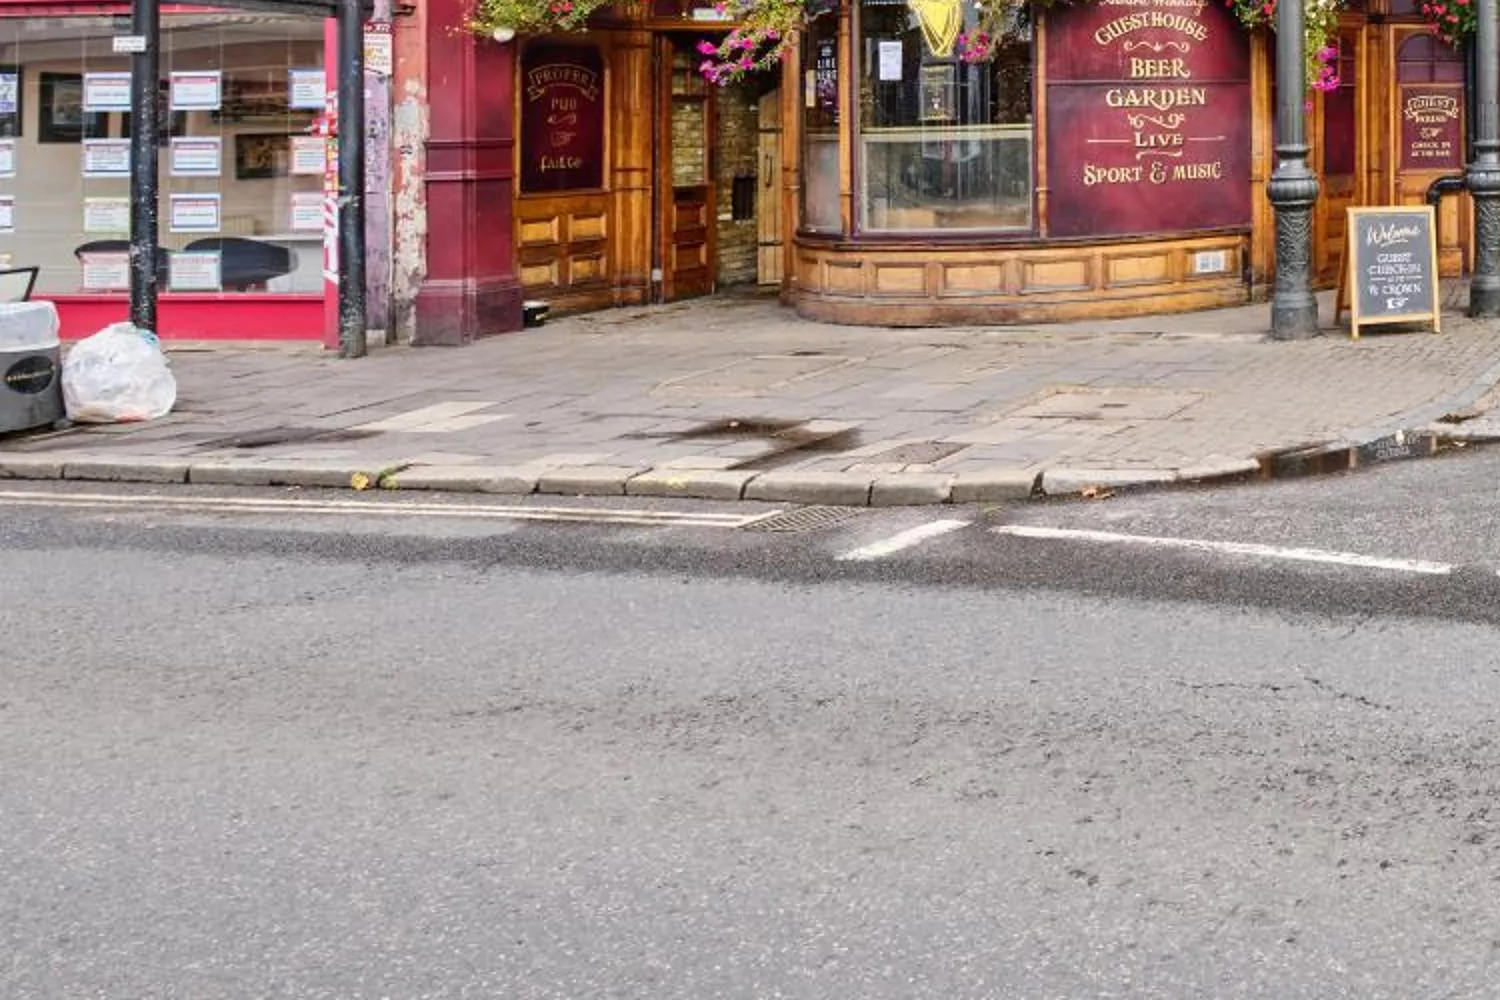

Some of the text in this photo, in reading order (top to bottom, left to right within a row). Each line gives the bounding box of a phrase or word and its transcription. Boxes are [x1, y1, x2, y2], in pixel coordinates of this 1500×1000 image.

[1094, 11, 1208, 46] GUESTHOUSE
[1129, 56, 1192, 80] BEER
[1104, 86, 1208, 111] GARDEN
[1150, 161, 1167, 185] &
